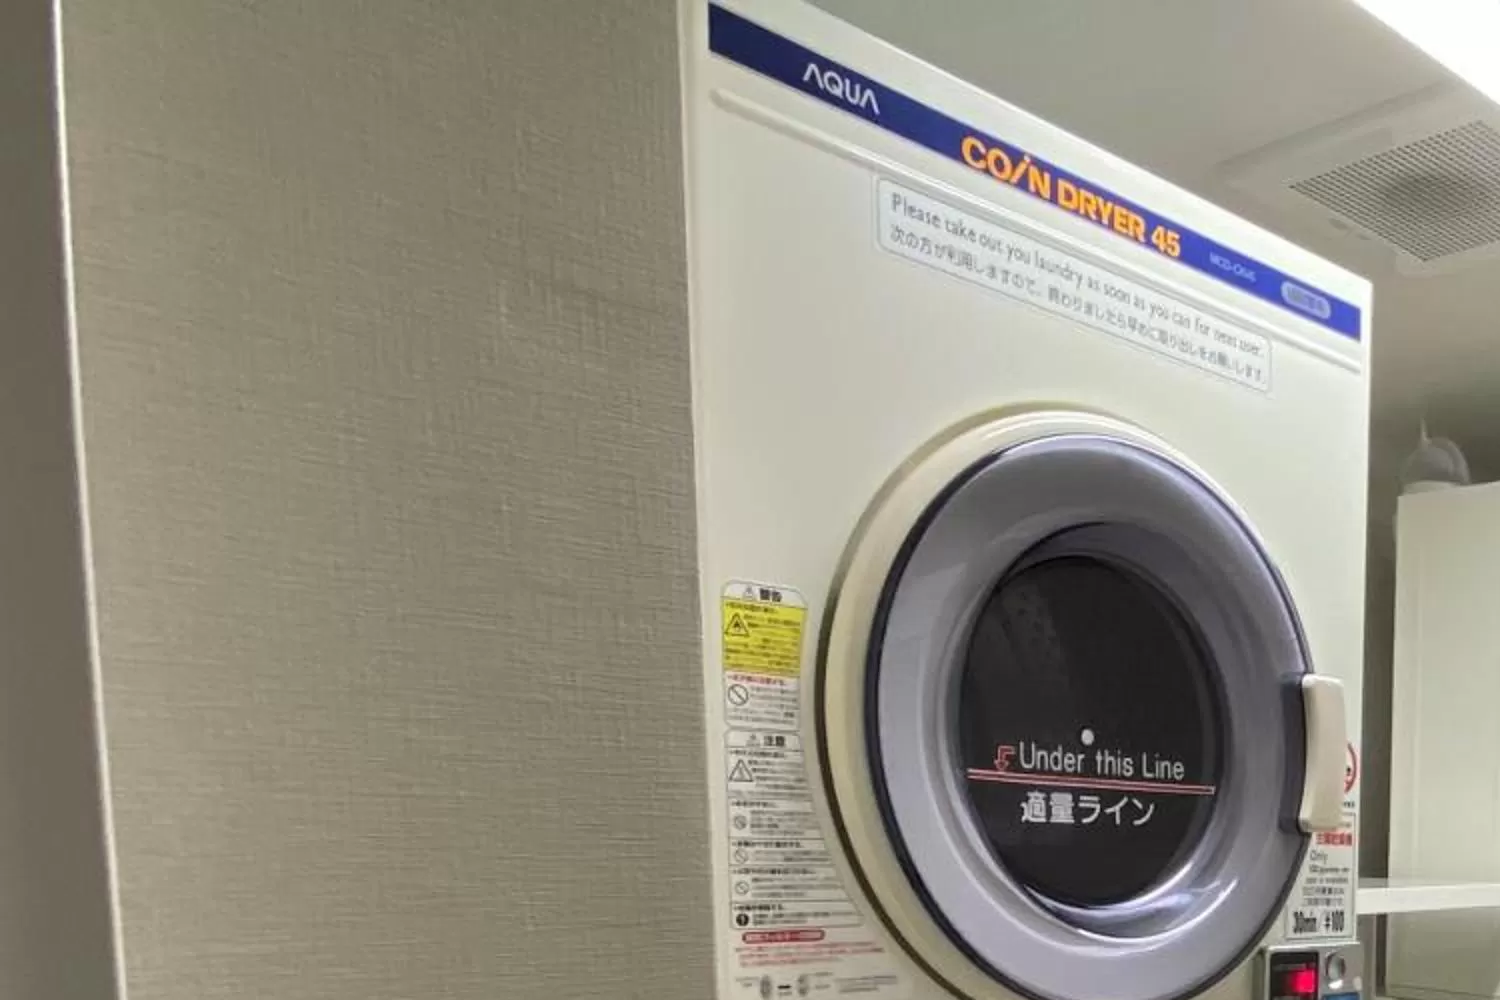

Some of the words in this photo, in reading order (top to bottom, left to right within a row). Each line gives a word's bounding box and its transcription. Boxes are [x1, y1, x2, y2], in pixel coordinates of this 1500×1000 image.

[802, 62, 880, 115] AQUA
[1057, 176, 1147, 243] DRYER
[1151, 224, 1182, 258] 45
[890, 191, 942, 230] Please
[944, 218, 977, 244] take
[979, 233, 1004, 254] out
[1006, 242, 1031, 265] you
[1034, 249, 1084, 292] laundry
[1087, 274, 1102, 290] as
[1103, 280, 1131, 304] soon
[1133, 292, 1146, 309] as
[1149, 297, 1170, 321] you
[1171, 306, 1191, 328] can
[1193, 314, 1211, 338] for
[1019, 741, 1084, 773] Under
[1096, 748, 1134, 777] this
[1142, 752, 1185, 780] Line
[1020, 790, 1155, 826] 適量ライン
